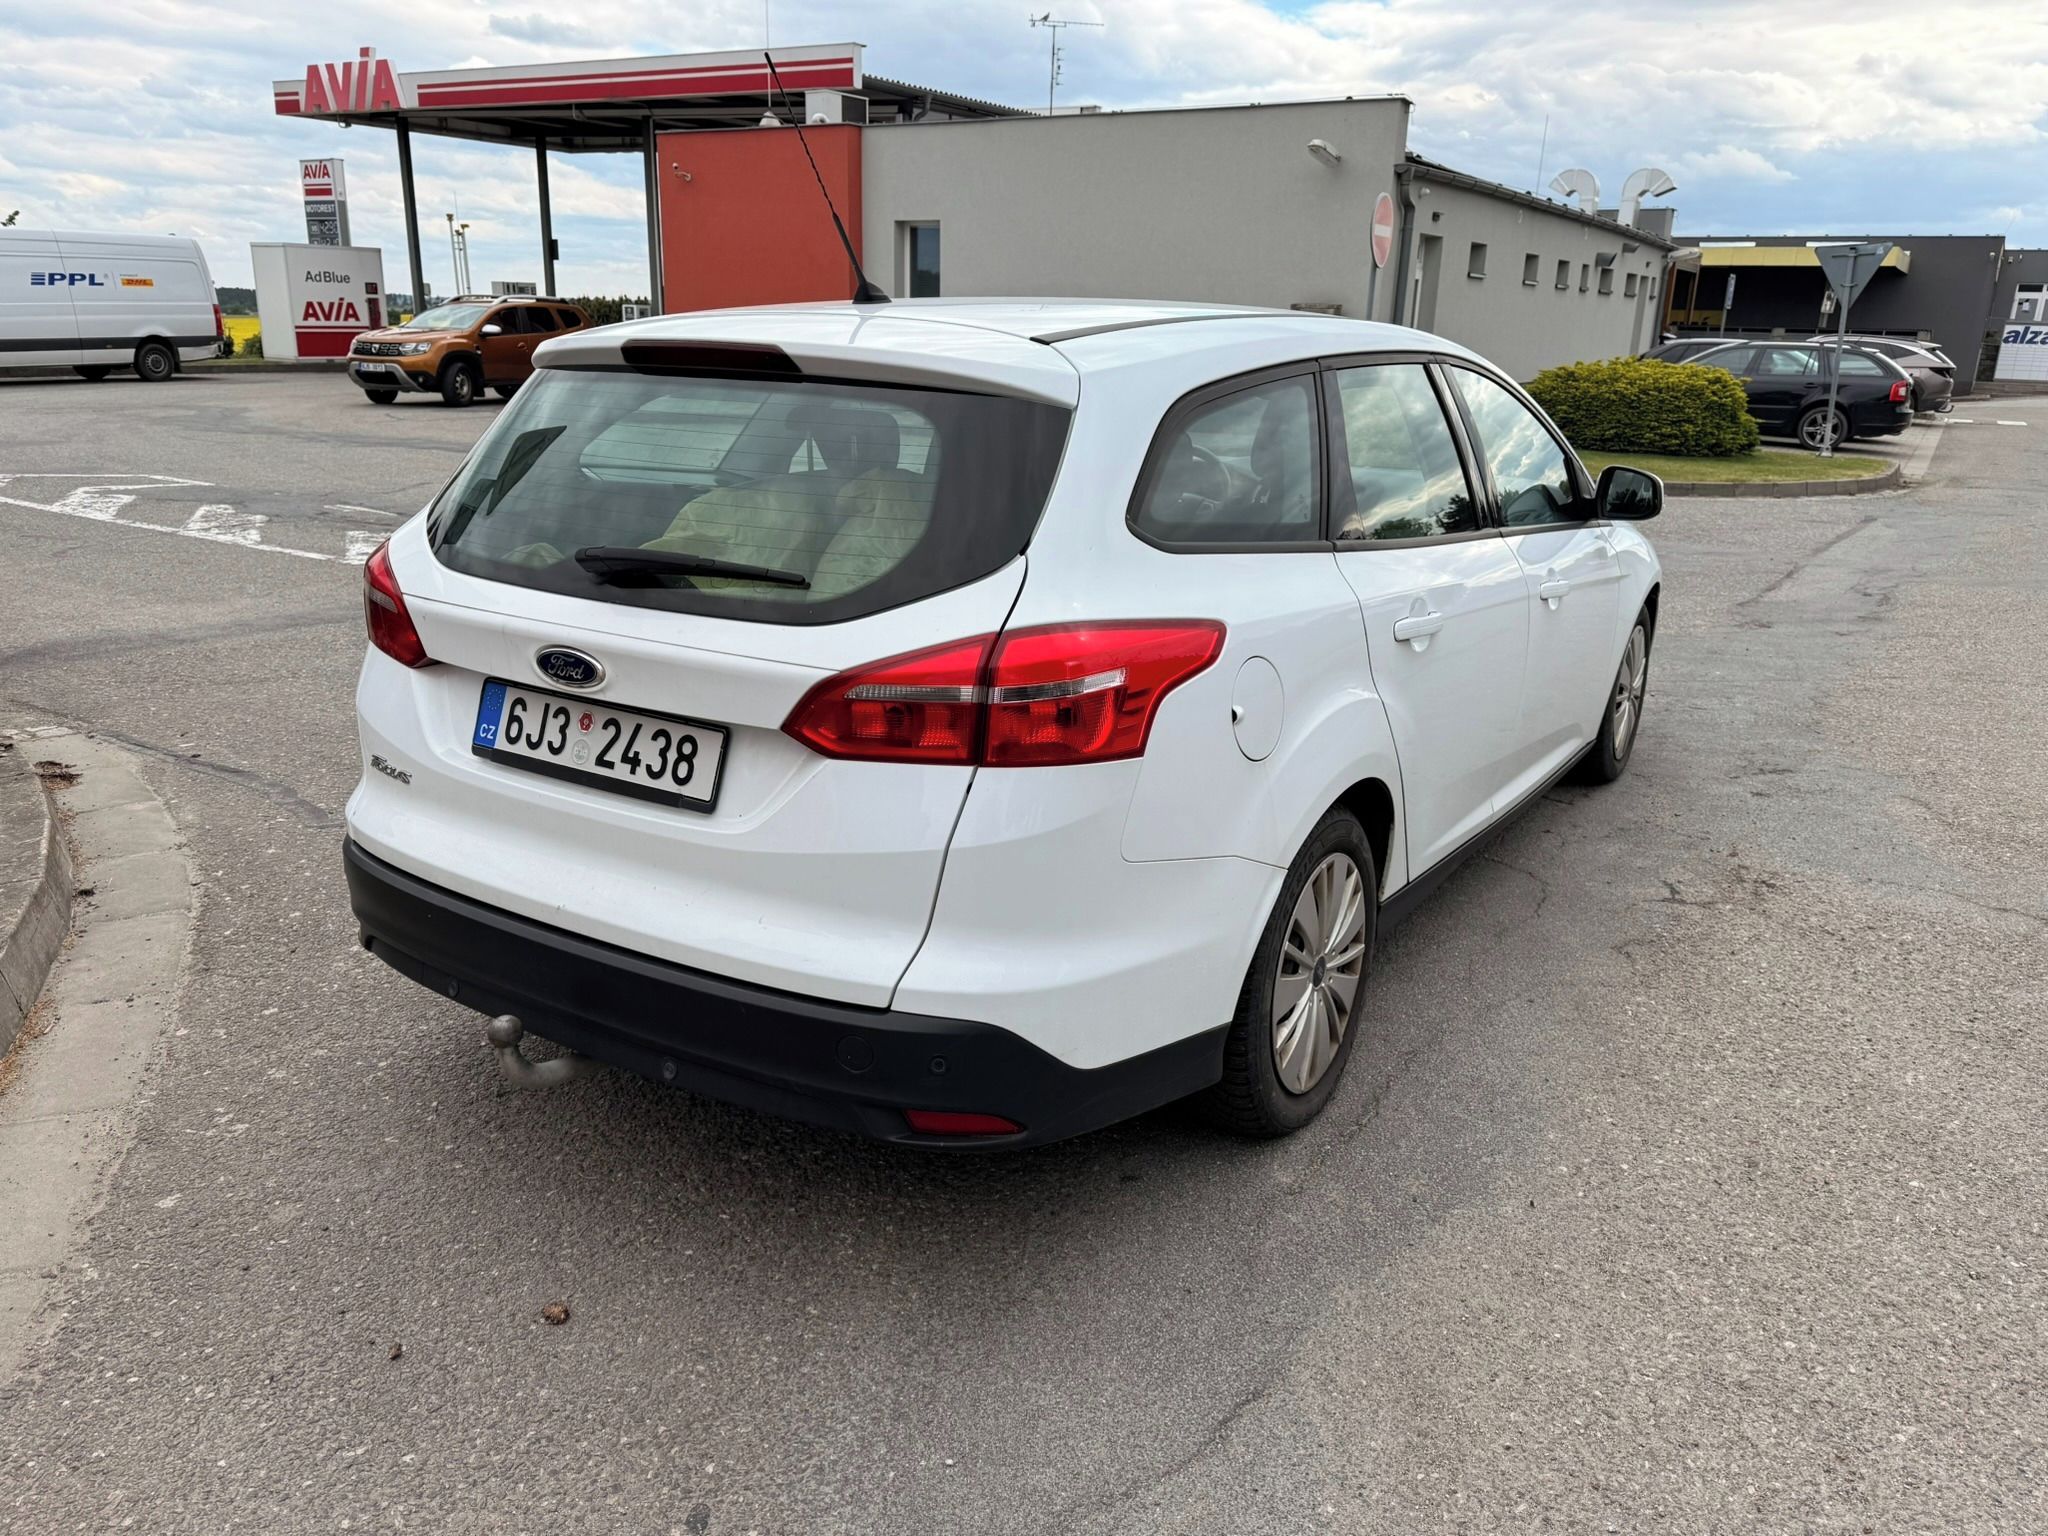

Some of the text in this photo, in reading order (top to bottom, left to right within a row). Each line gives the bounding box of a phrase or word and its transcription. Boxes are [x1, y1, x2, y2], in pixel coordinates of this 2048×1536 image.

[304, 47, 402, 113] AVIA
[303, 160, 331, 179] AVIA
[305, 204, 336, 213] MOTOREST
[48, 272, 104, 286] PPL
[305, 270, 351, 284] AdBlue
[302, 297, 361, 322] AVIA
[547, 653, 585, 680] Ford
[479, 723, 496, 741] CZ
[504, 696, 699, 787] 6J3 2438
